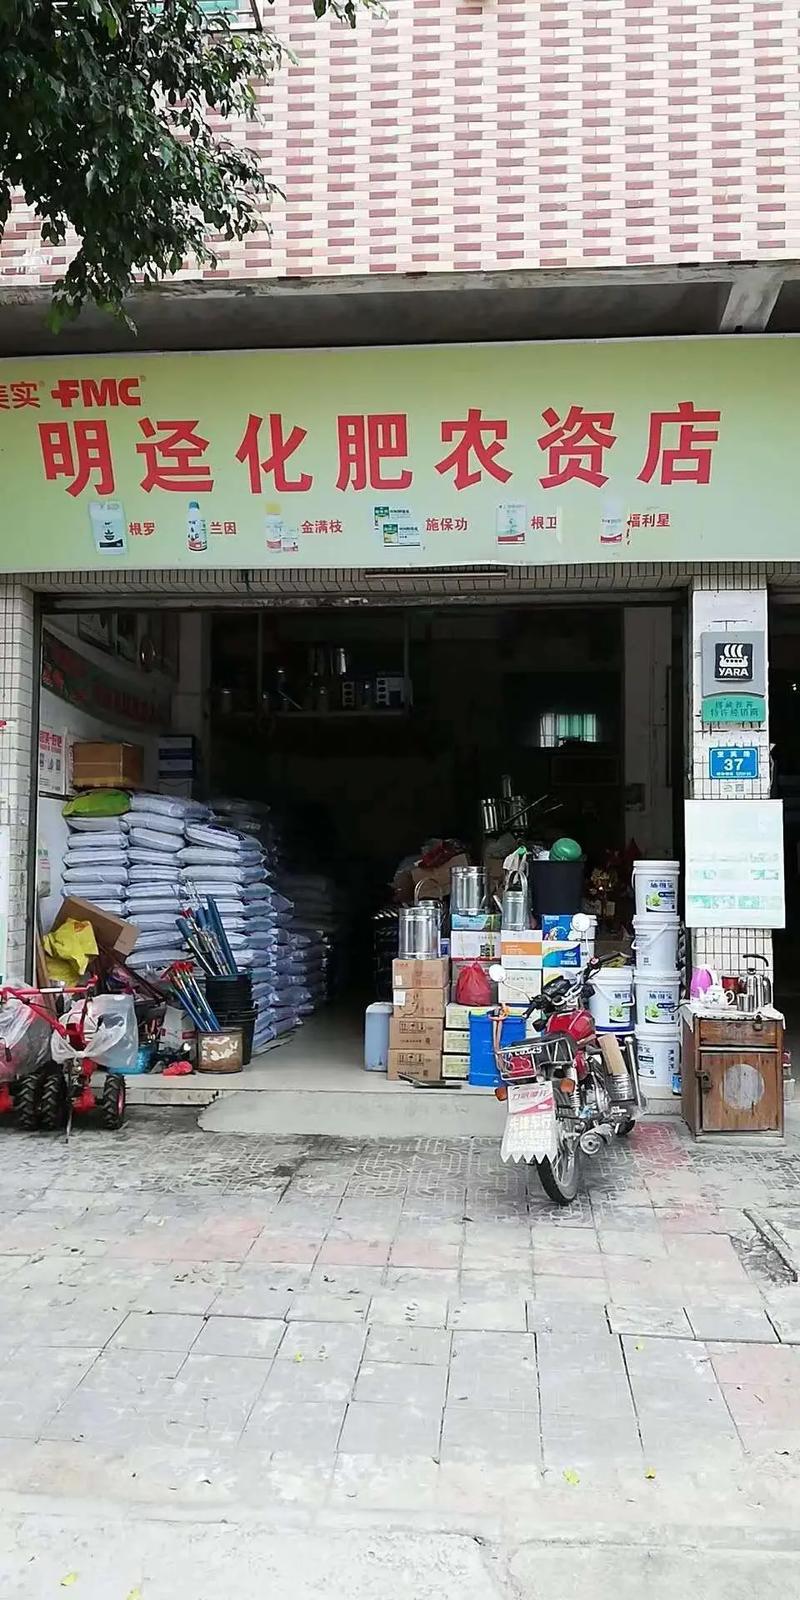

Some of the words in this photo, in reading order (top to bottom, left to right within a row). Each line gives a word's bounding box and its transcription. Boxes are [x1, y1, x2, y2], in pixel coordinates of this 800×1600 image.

[51, 377, 142, 408] FMC
[37, 401, 721, 497] 明迳化肥农资店
[128, 521, 156, 536] 根罗
[210, 521, 237, 536] 兰因
[301, 519, 344, 535] 金满枝
[425, 517, 468, 532] 施保功
[718, 667, 749, 677] YARA
[723, 757, 744, 771] 37
